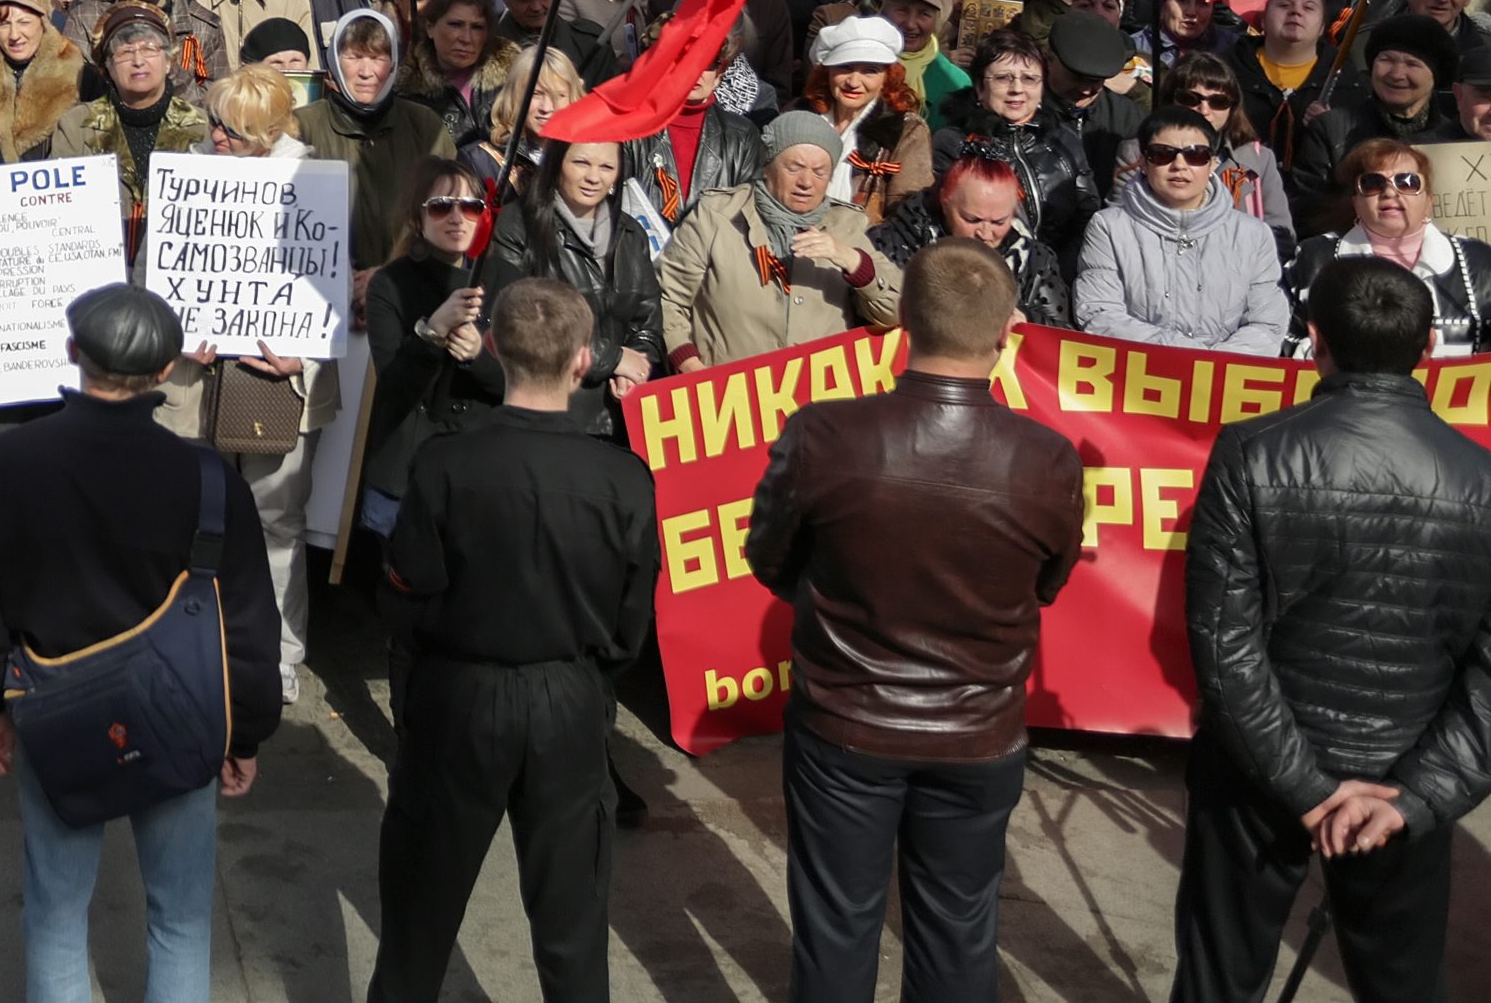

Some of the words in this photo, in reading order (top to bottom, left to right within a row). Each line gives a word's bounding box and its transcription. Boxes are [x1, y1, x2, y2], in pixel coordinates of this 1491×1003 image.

[10, 165, 87, 193] POLE
[20, 192, 73, 207] CONTRE
[15, 218, 58, 232] POUVOIR
[156, 203, 264, 240] ЯЦЕНЮК
[51, 225, 95, 237] CENTRAL
[48, 239, 101, 254] STANDARDS
[157, 240, 339, 280] САМОЗВАНЦЫ!
[32, 286, 46, 295] DU
[52, 283, 76, 294] PAYS
[166, 277, 294, 305] ХУНТА
[0, 339, 47, 353] FASCISME
